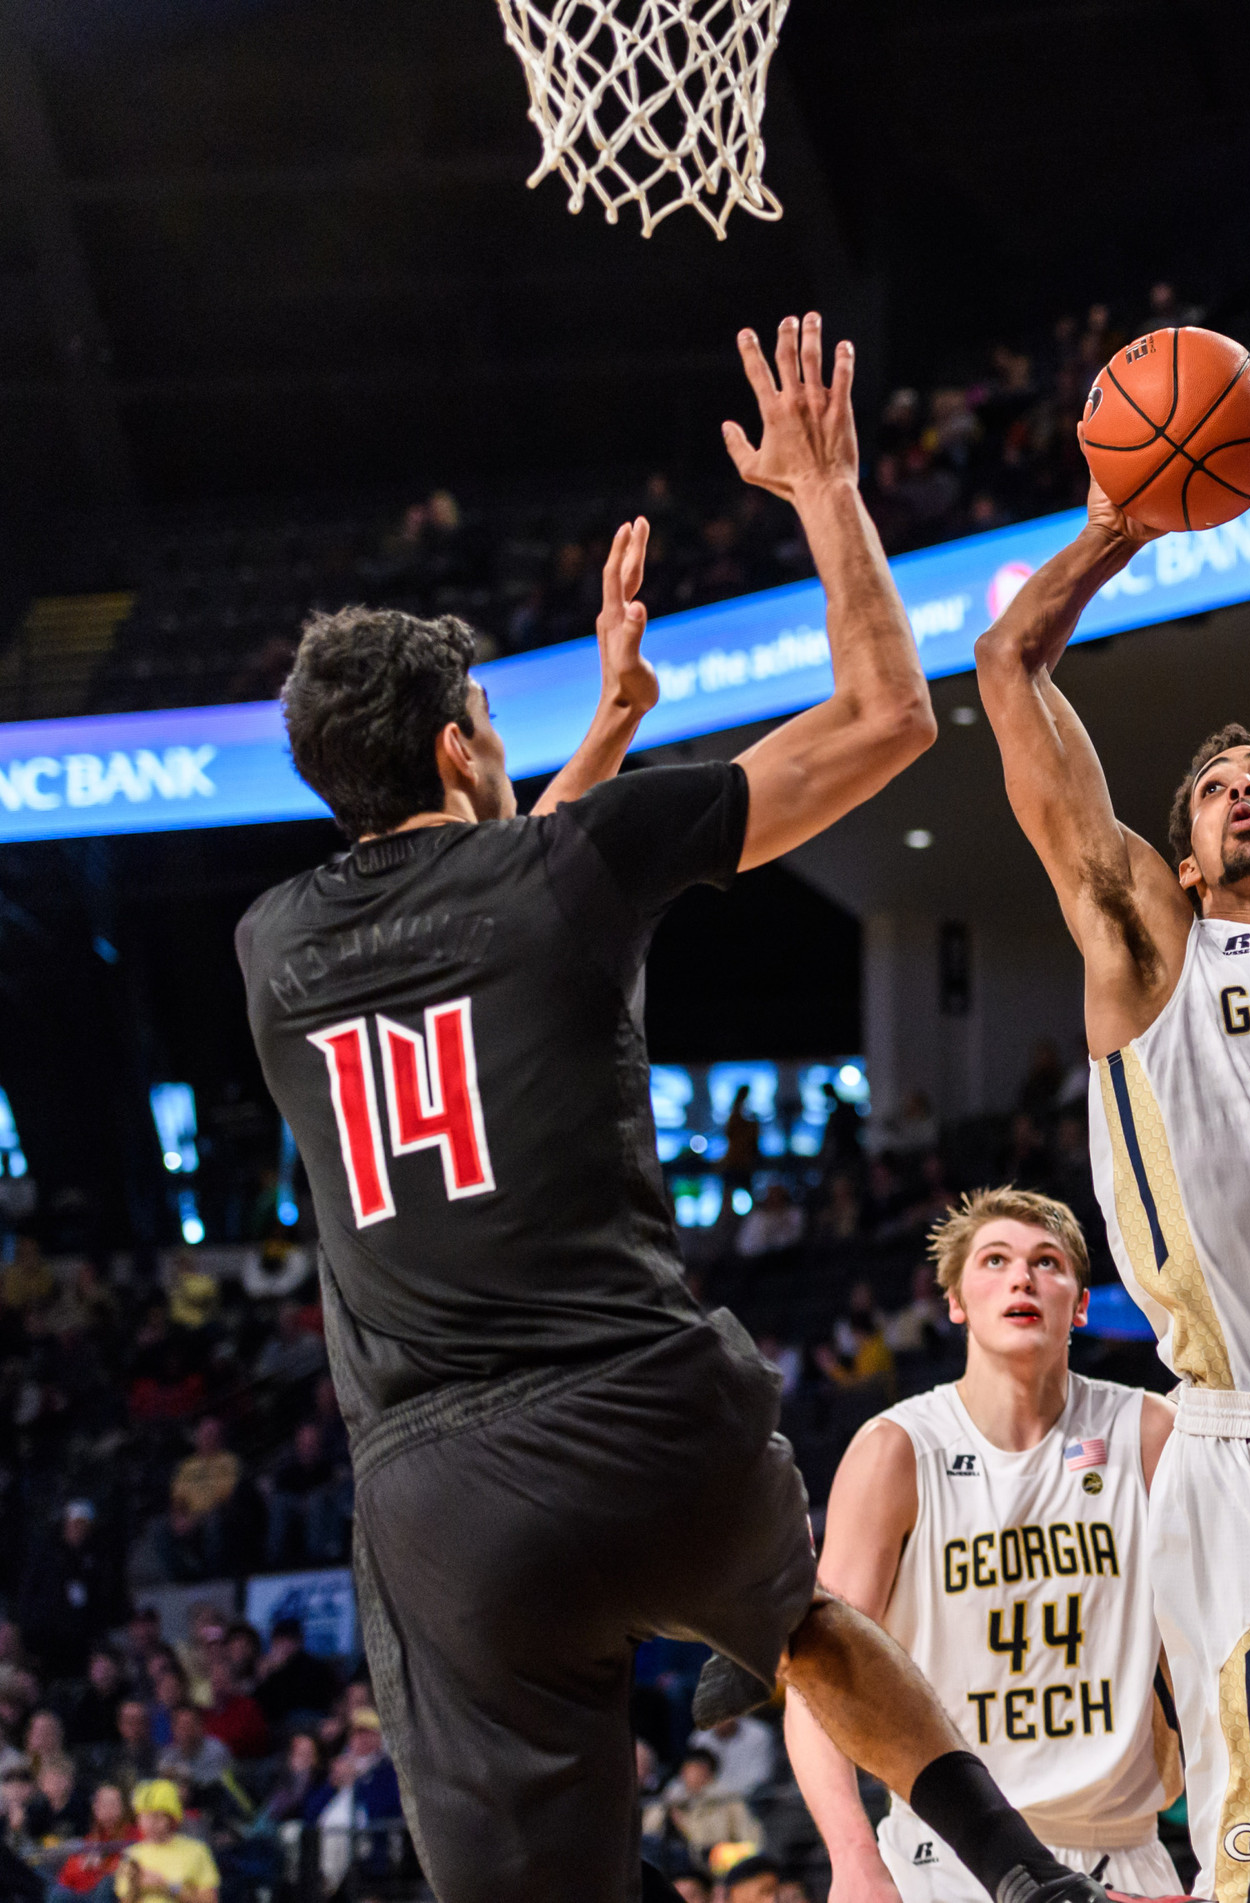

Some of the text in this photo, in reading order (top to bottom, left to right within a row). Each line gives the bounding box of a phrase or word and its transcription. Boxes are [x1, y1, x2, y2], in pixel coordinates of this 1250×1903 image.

[699, 648, 749, 692] the
[751, 624, 831, 680] achie
[65, 743, 217, 807] BANK
[306, 996, 496, 1228] 14
[944, 1522, 1120, 1594] GEORGIA
[987, 1593, 1085, 1675] 44
[967, 1678, 1114, 1744] TECH
